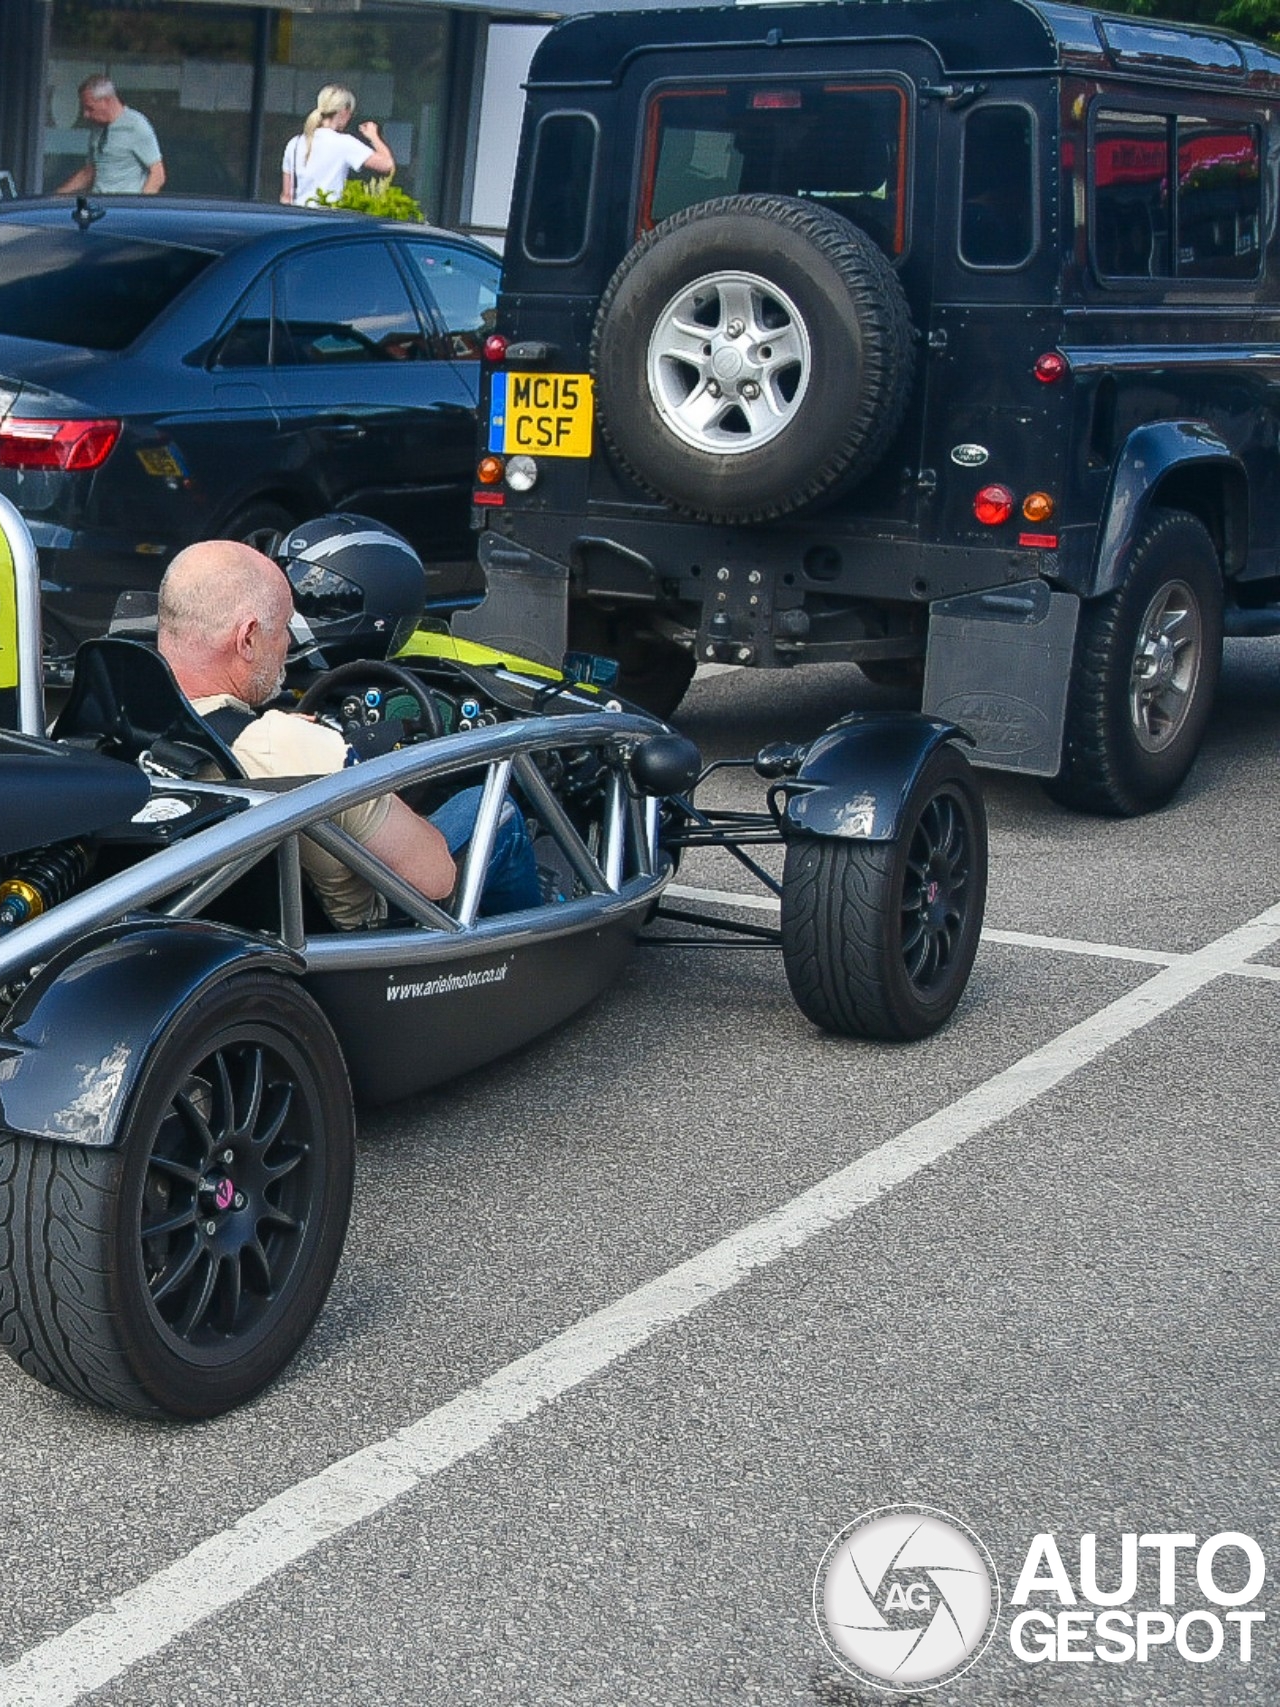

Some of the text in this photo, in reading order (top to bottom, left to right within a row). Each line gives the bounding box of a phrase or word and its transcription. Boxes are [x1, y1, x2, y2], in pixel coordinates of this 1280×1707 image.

[513, 377, 579, 410] MC15
[516, 415, 574, 447] CSF
[386, 962, 508, 1001] www.arielmotor.co.uk
